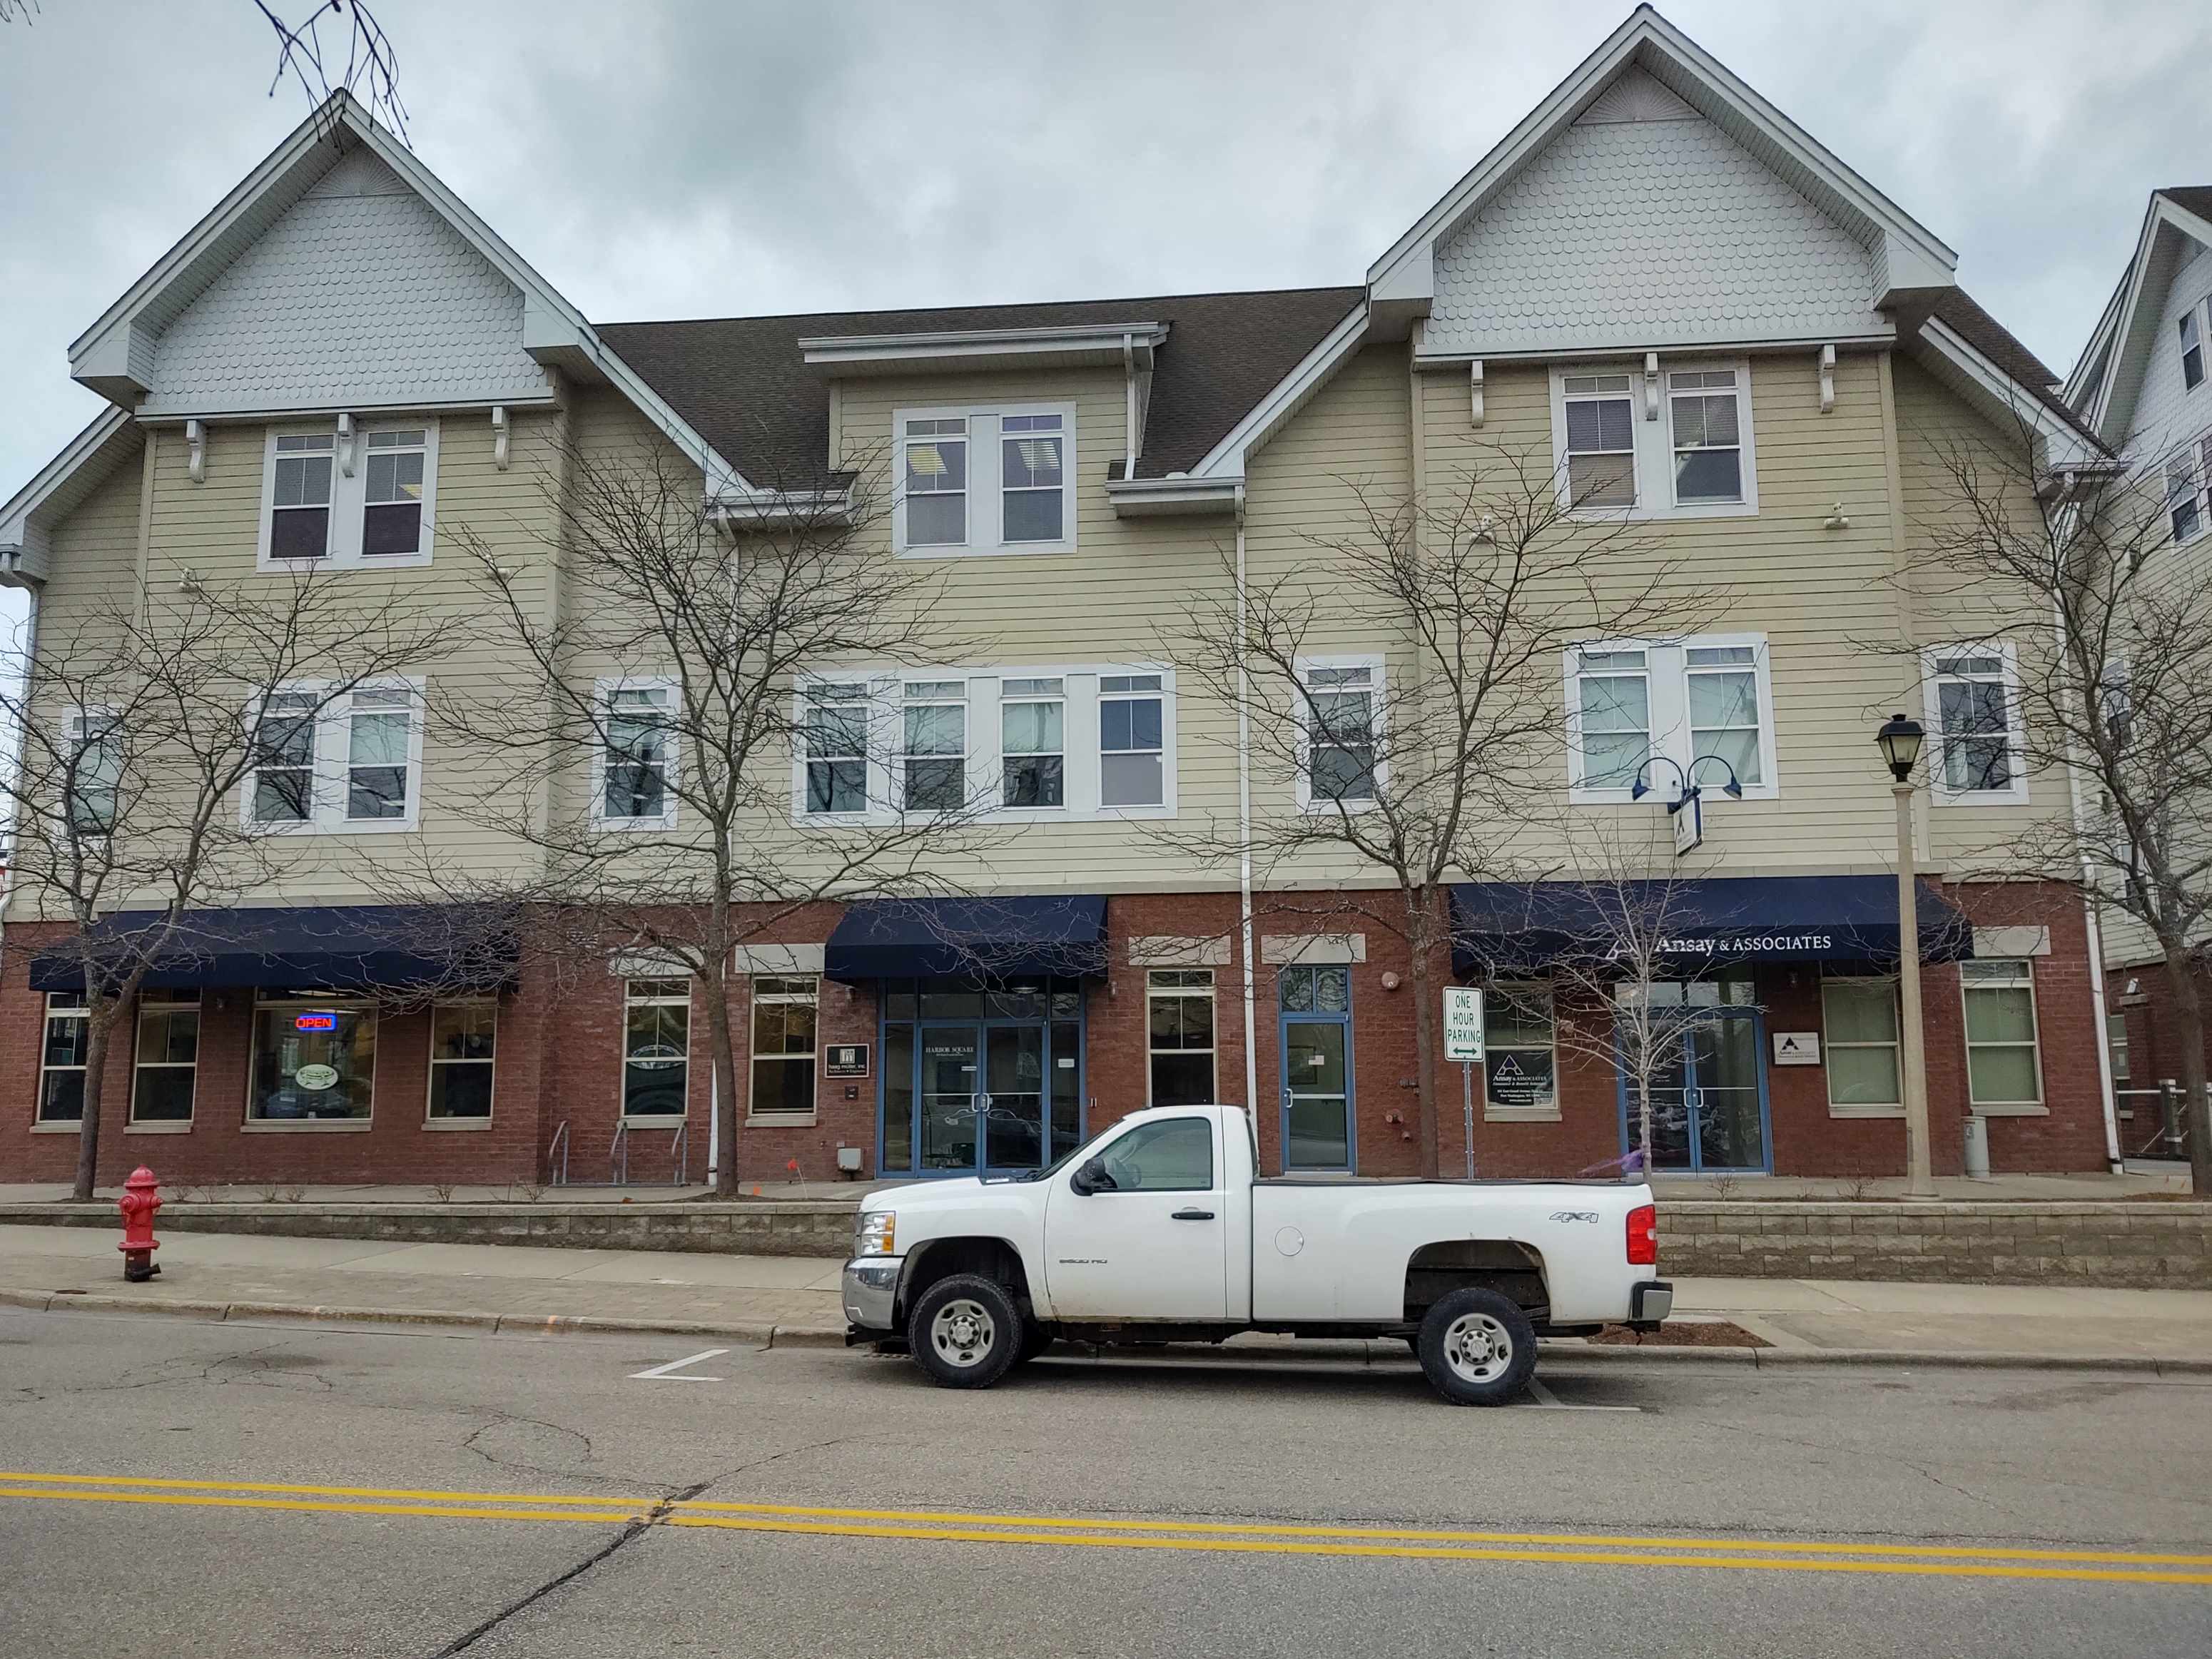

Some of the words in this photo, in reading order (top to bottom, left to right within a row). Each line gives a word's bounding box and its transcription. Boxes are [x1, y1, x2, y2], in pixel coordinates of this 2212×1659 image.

[1653, 936, 1715, 956] Ansay
[1720, 940, 1730, 951] &
[1732, 935, 1832, 951] ASSOCIATES
[1456, 995, 1471, 1008] ONE
[296, 1018, 332, 1028] OPEN
[1453, 1011, 1474, 1025] HOUR
[1447, 1029, 1481, 1042] PARKING
